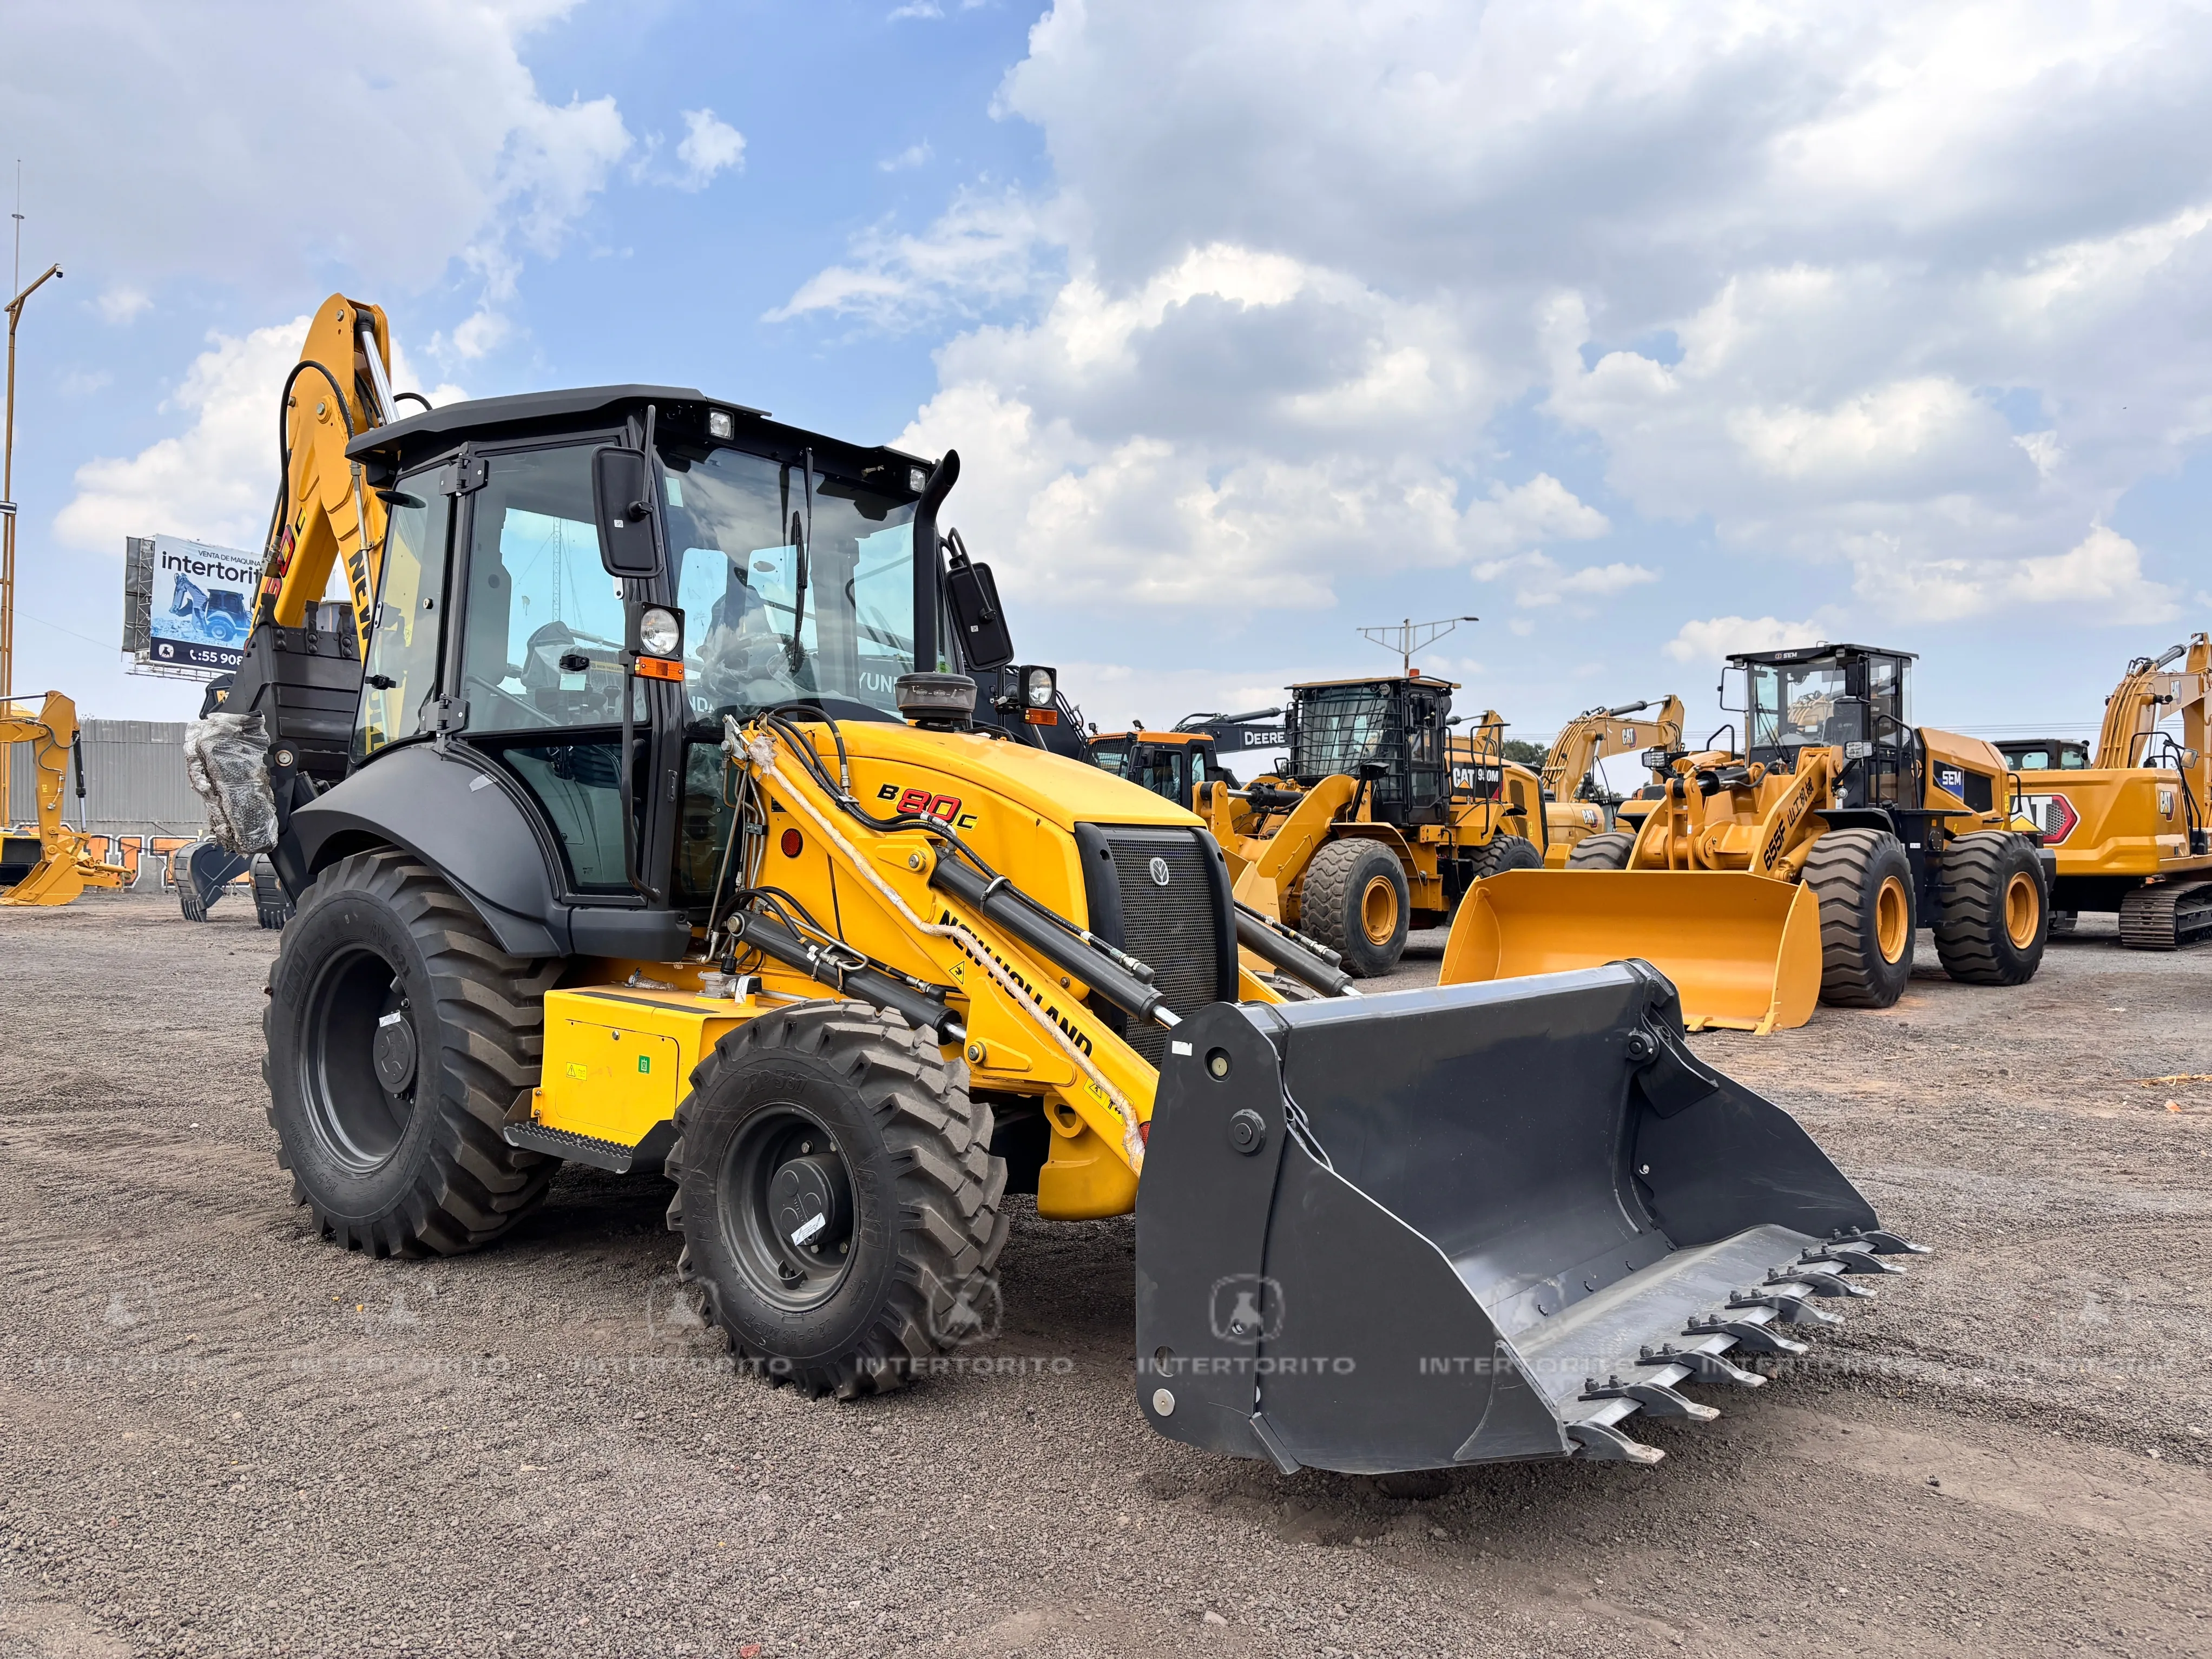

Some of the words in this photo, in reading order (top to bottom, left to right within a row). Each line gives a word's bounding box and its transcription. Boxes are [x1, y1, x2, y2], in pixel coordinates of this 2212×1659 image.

[198, 550, 220, 559] VENTA
[1245, 732, 1286, 746] DEERE
[1622, 728, 1634, 745] CAT
[1453, 767, 1474, 789] CAT
[1943, 771, 1961, 786] SEM
[2160, 791, 2171, 813] CAT
[1582, 809, 1595, 824] CAT
[2010, 796, 2052, 832] AT
[1763, 819, 1786, 871] 655F
[1787, 777, 1814, 828] 山工机械
